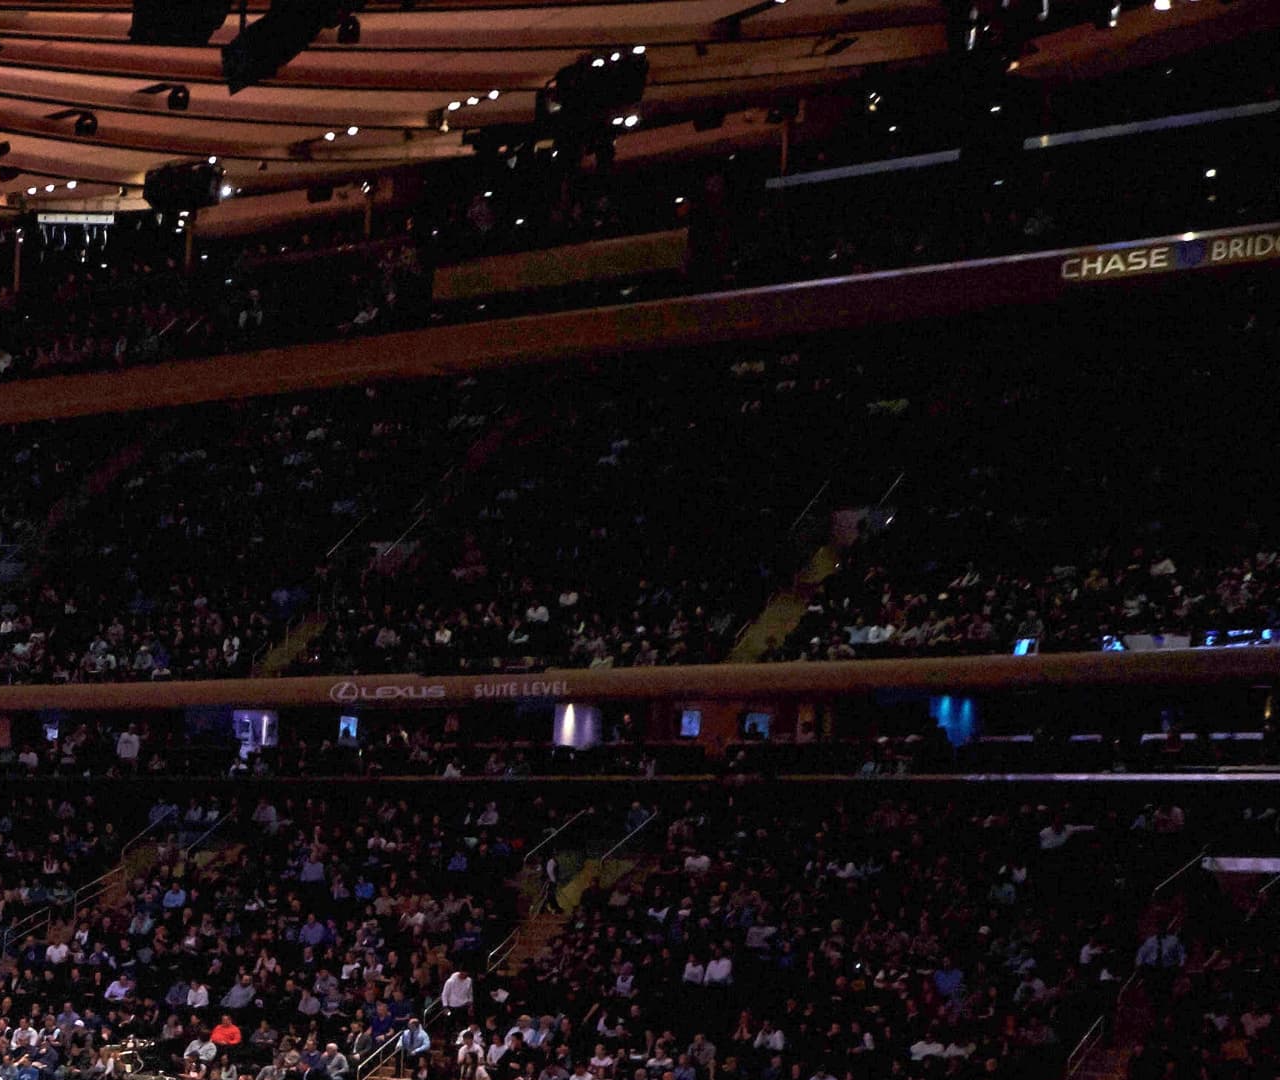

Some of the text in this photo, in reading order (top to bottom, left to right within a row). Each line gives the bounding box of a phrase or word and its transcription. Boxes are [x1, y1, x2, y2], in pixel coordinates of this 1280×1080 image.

[1061, 234, 1280, 279] CHASE BRID
[361, 680, 570, 699] LEXUS SUITE LEVEL
